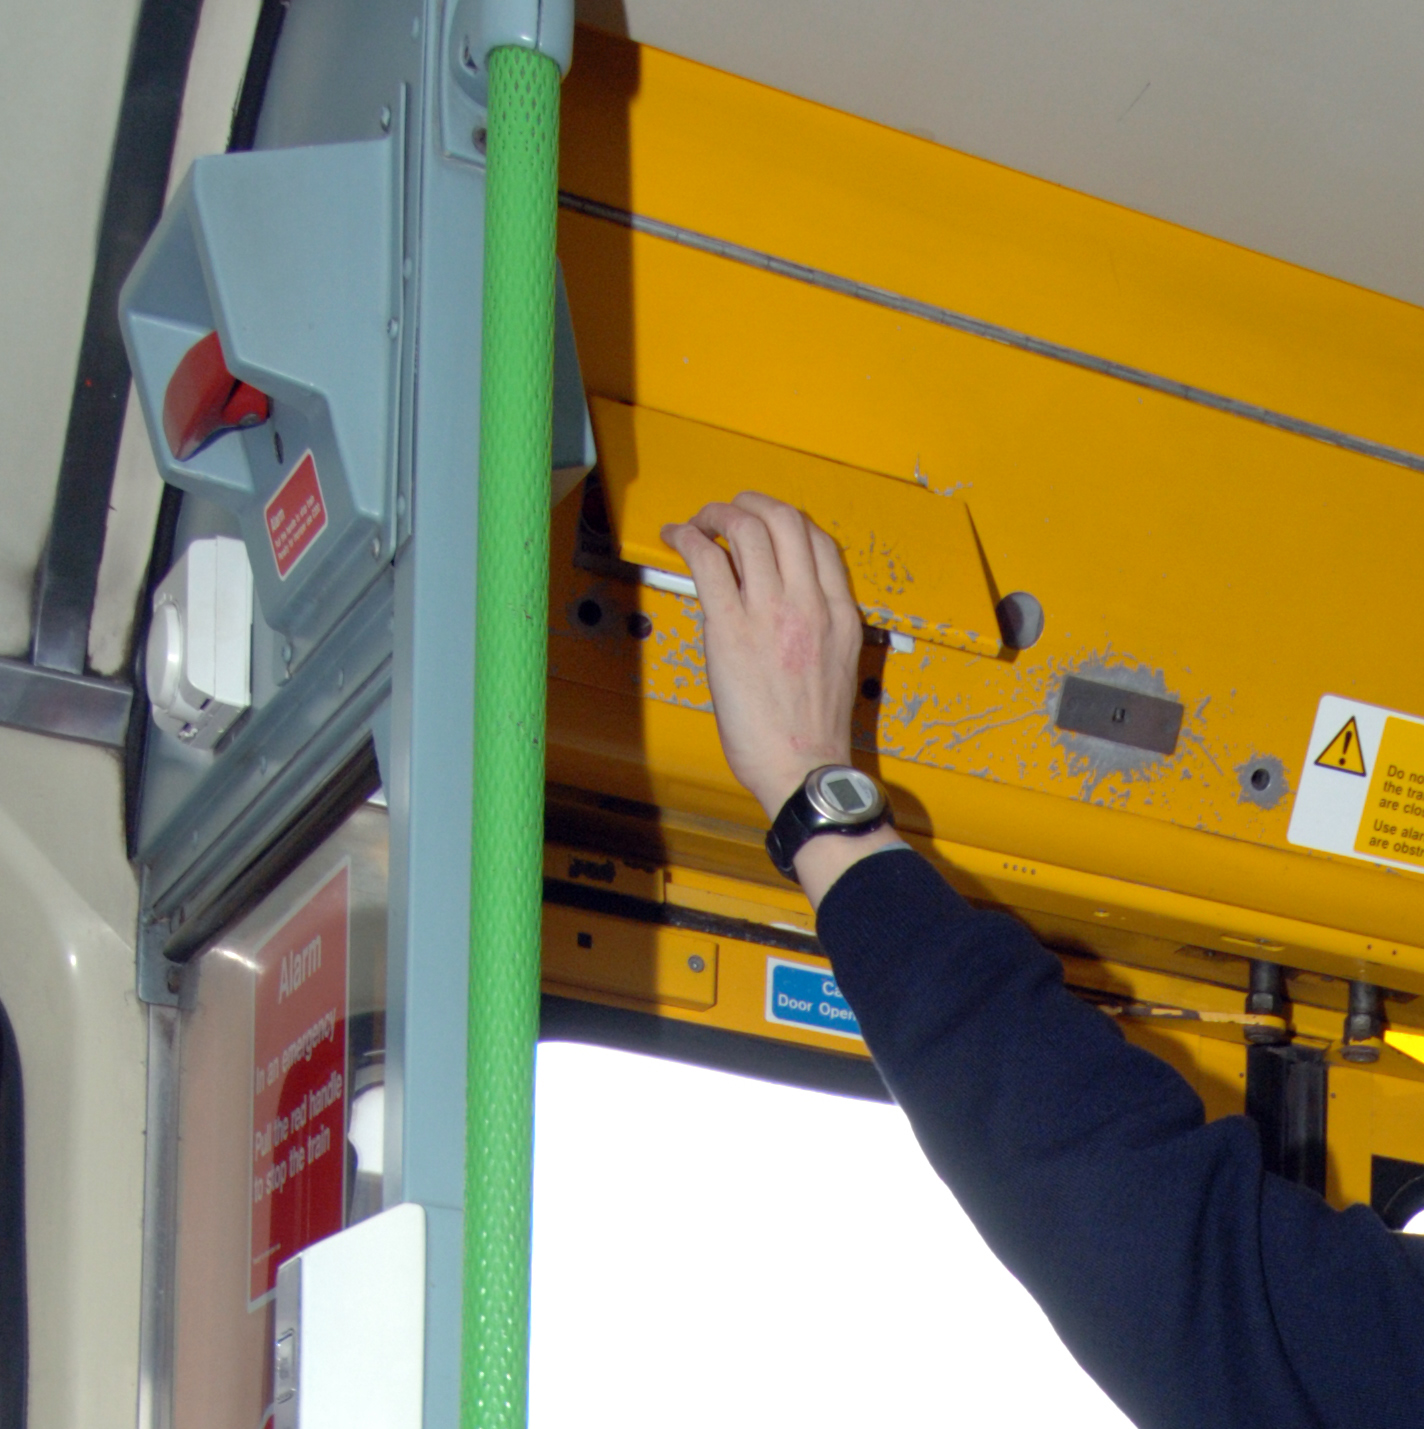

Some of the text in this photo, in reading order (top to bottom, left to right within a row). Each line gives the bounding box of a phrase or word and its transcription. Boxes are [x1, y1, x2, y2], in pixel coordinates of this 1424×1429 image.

[1387, 765, 1404, 779] Do
[1383, 781, 1403, 795] the
[1379, 798, 1399, 811] are
[1374, 819, 1397, 835] Use
[1369, 836, 1389, 849] are
[279, 935, 322, 1004] Alarm
[823, 981, 843, 997] Ca
[778, 994, 857, 1021] Door Open
[256, 1008, 336, 1095] In an emergency
[255, 1070, 342, 1161] Pull the red handle
[254, 1124, 330, 1203] to stop the train
